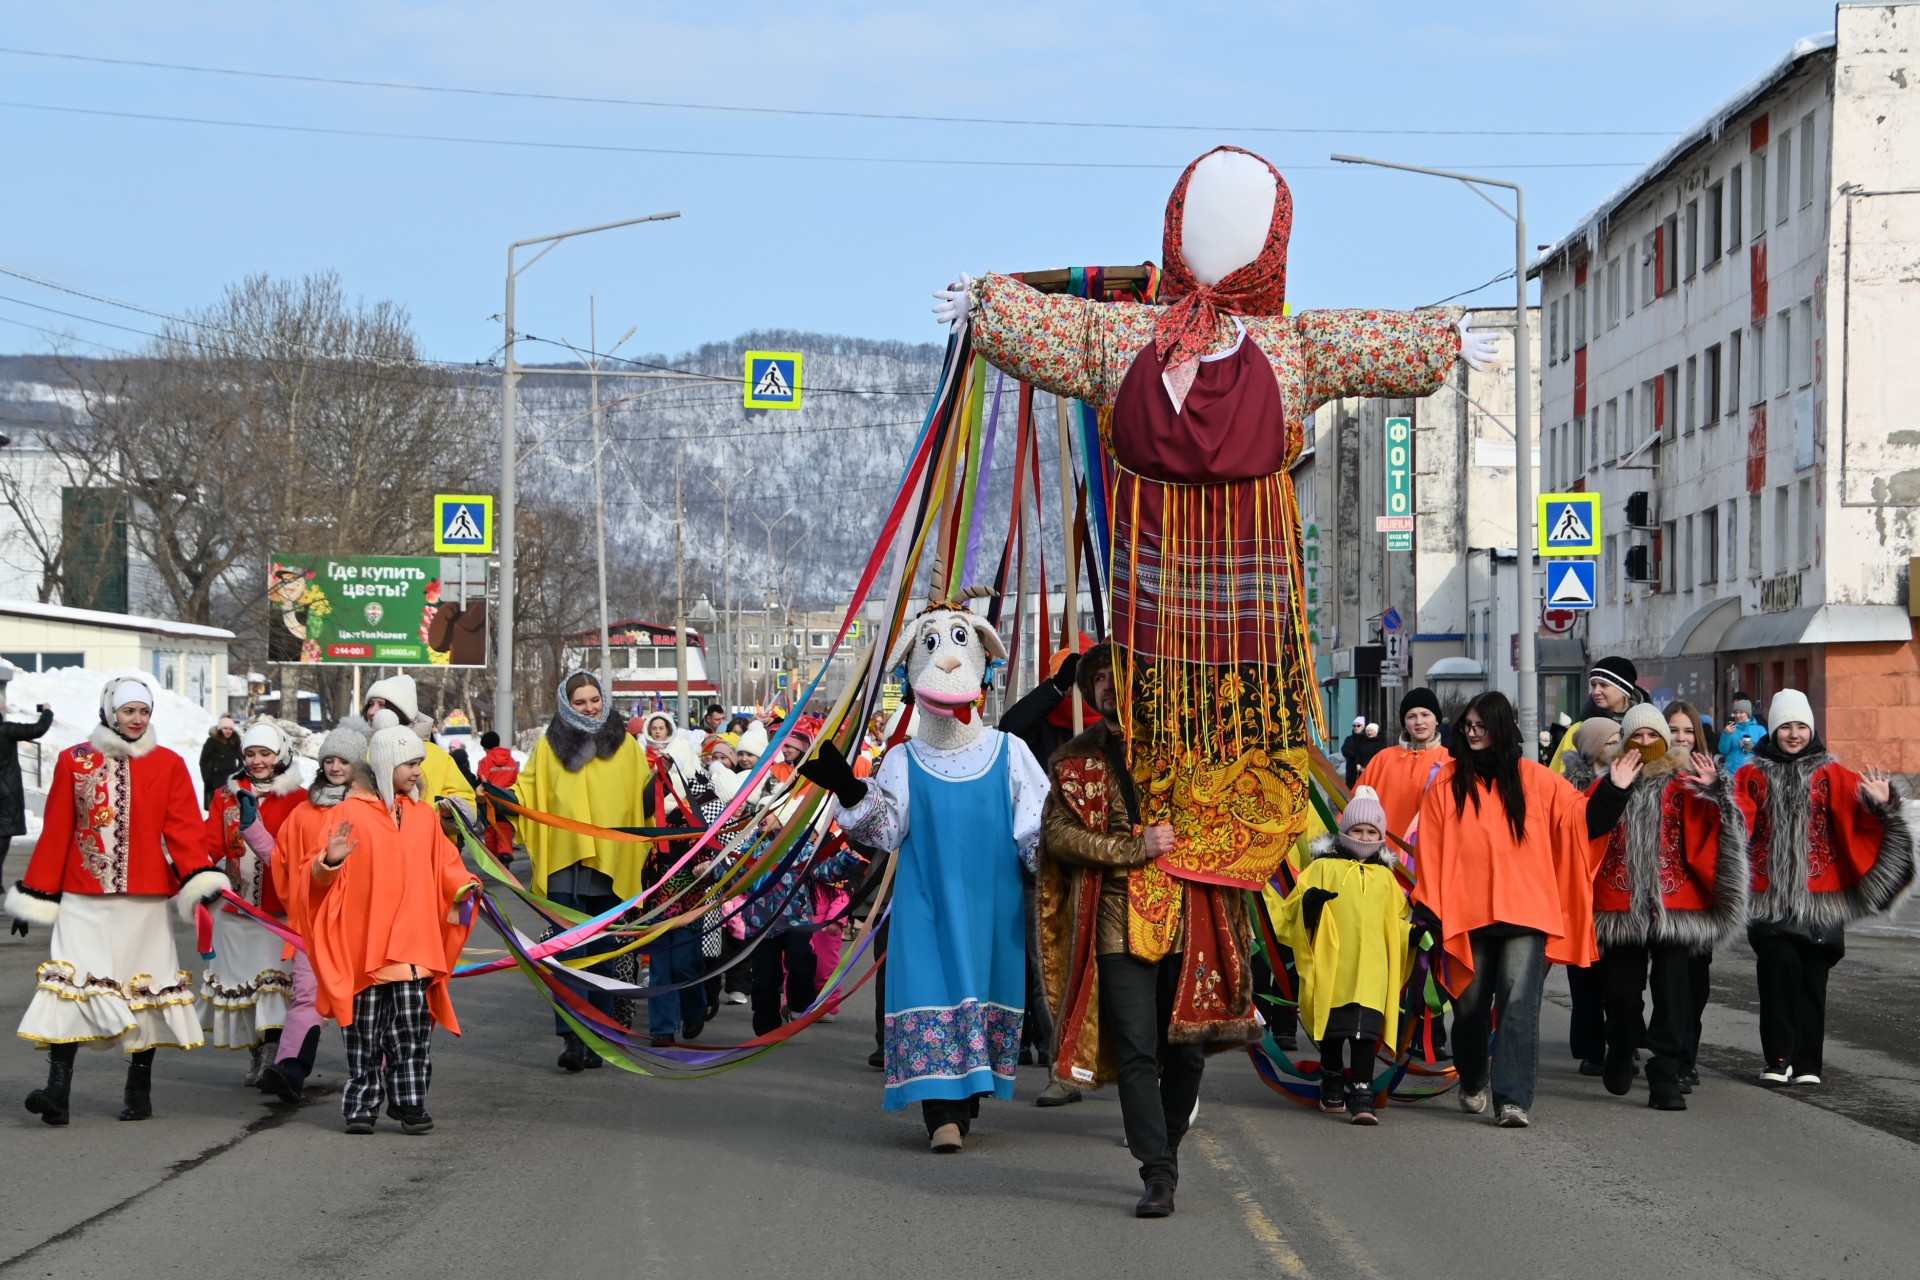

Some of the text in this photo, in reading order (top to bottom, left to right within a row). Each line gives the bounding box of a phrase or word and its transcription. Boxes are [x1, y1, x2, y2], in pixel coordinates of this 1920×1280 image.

[1389, 422, 1407, 512] ФОТО
[1378, 518, 1412, 530] FUJIFILM
[327, 561, 426, 582] Где купить
[342, 581, 410, 599] цветы?
[1306, 523, 1322, 646] АПТЕКА
[380, 648, 417, 656] 344005.ru
